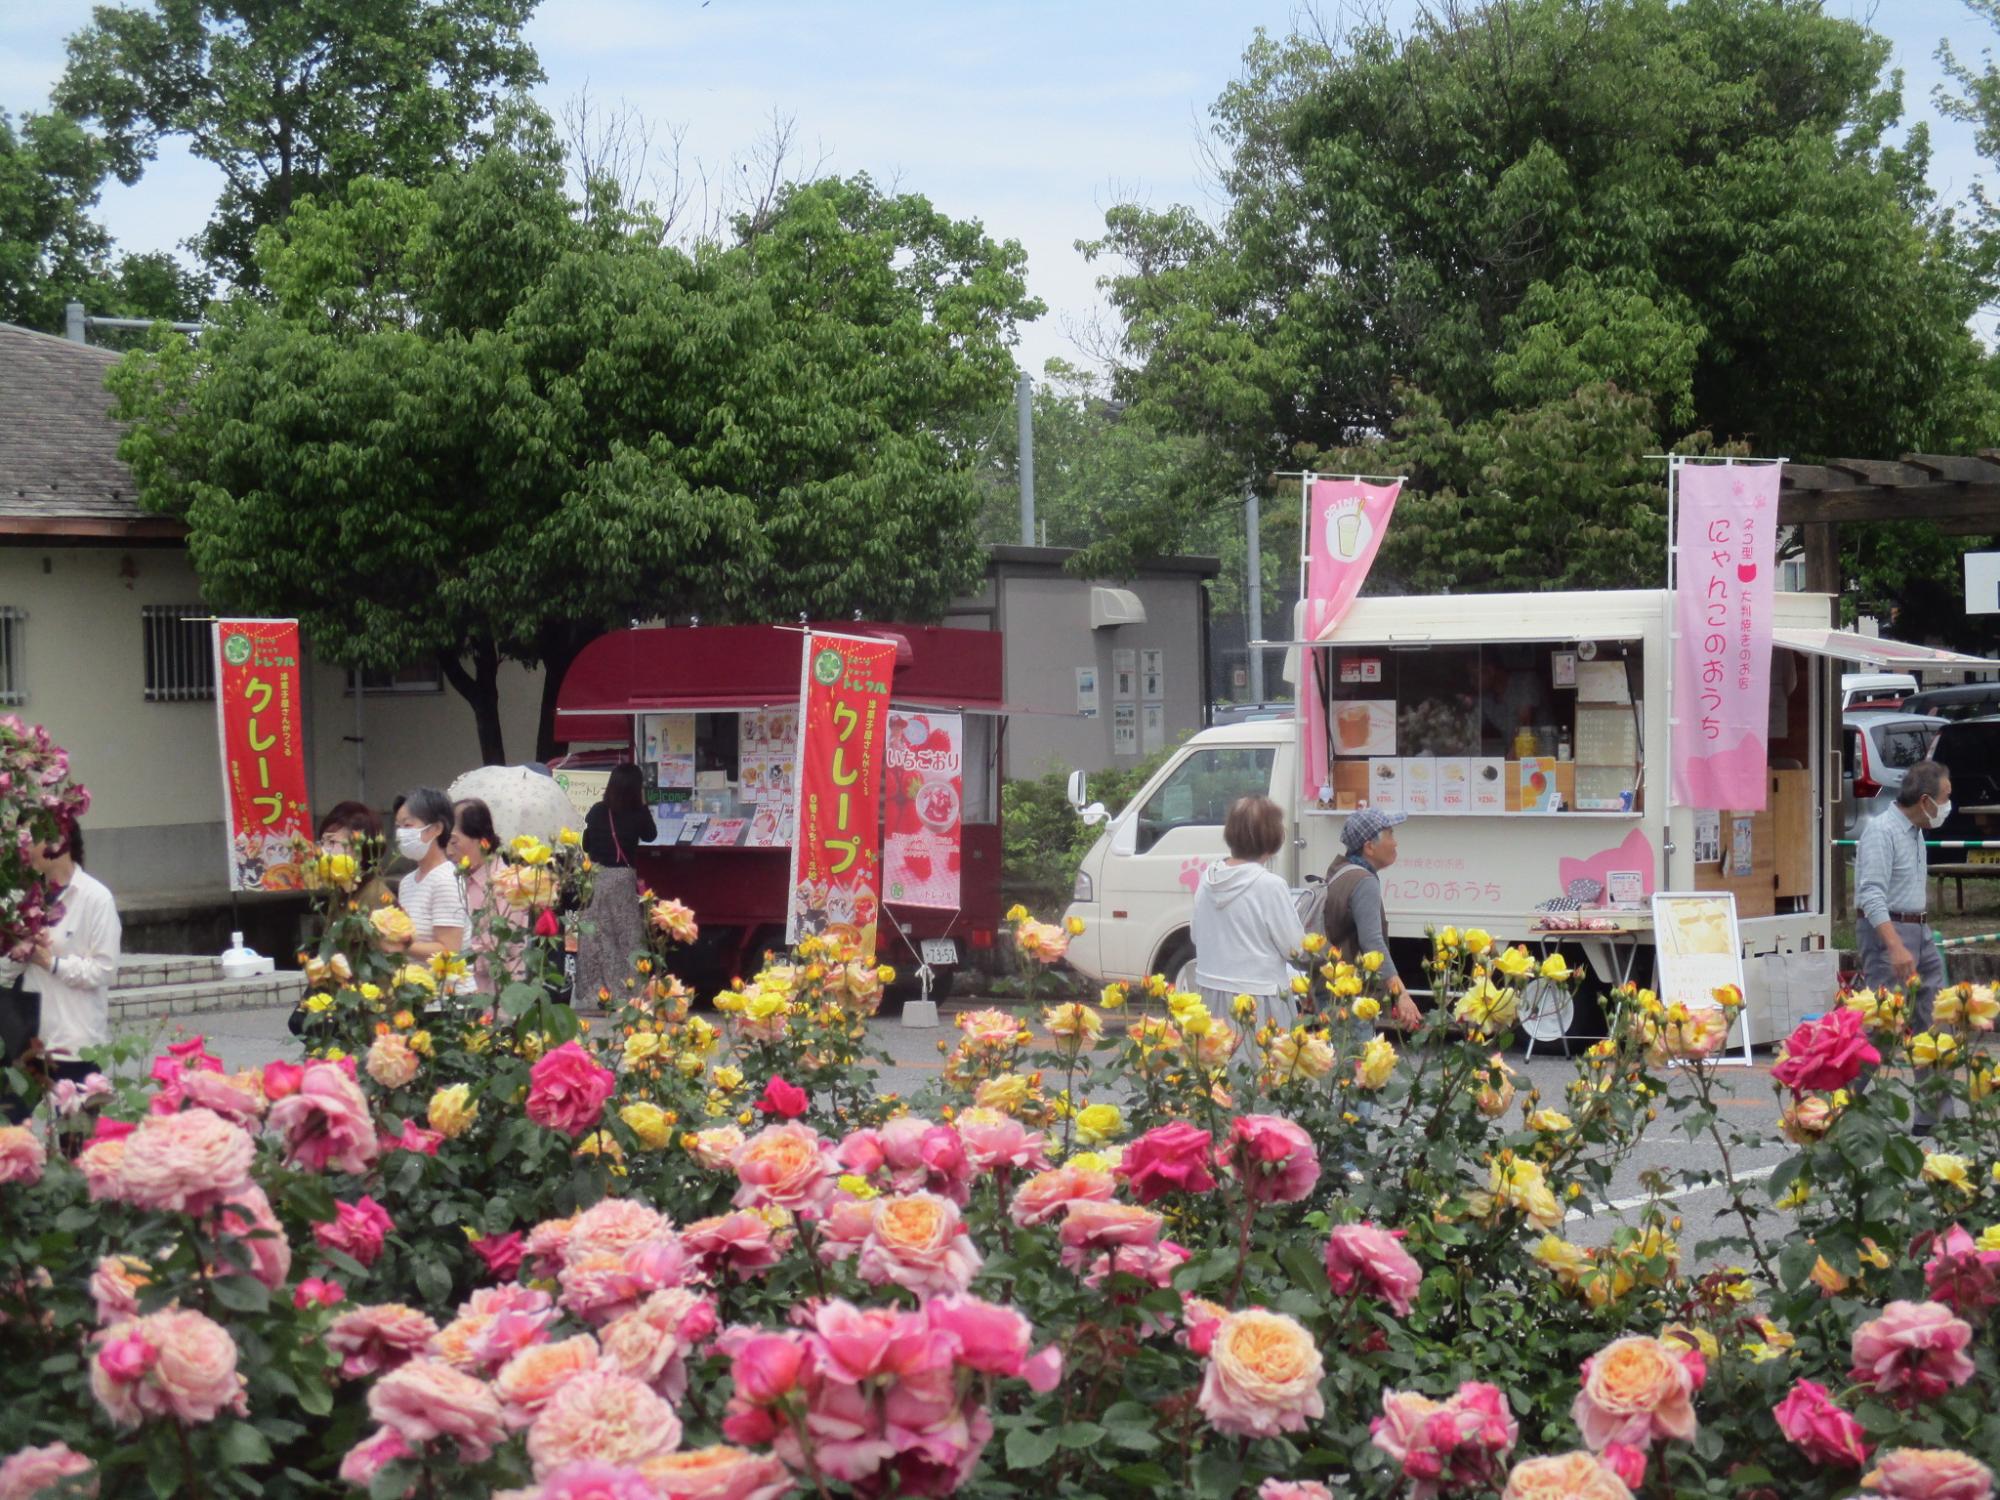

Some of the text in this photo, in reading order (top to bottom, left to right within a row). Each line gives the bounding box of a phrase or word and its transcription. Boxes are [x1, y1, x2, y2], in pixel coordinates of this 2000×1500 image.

[1701, 519, 1731, 740] にゃんこのおうち
[245, 677, 283, 825] クレープ
[824, 701, 860, 875] クレープ
[886, 748, 960, 772] いちごおり
